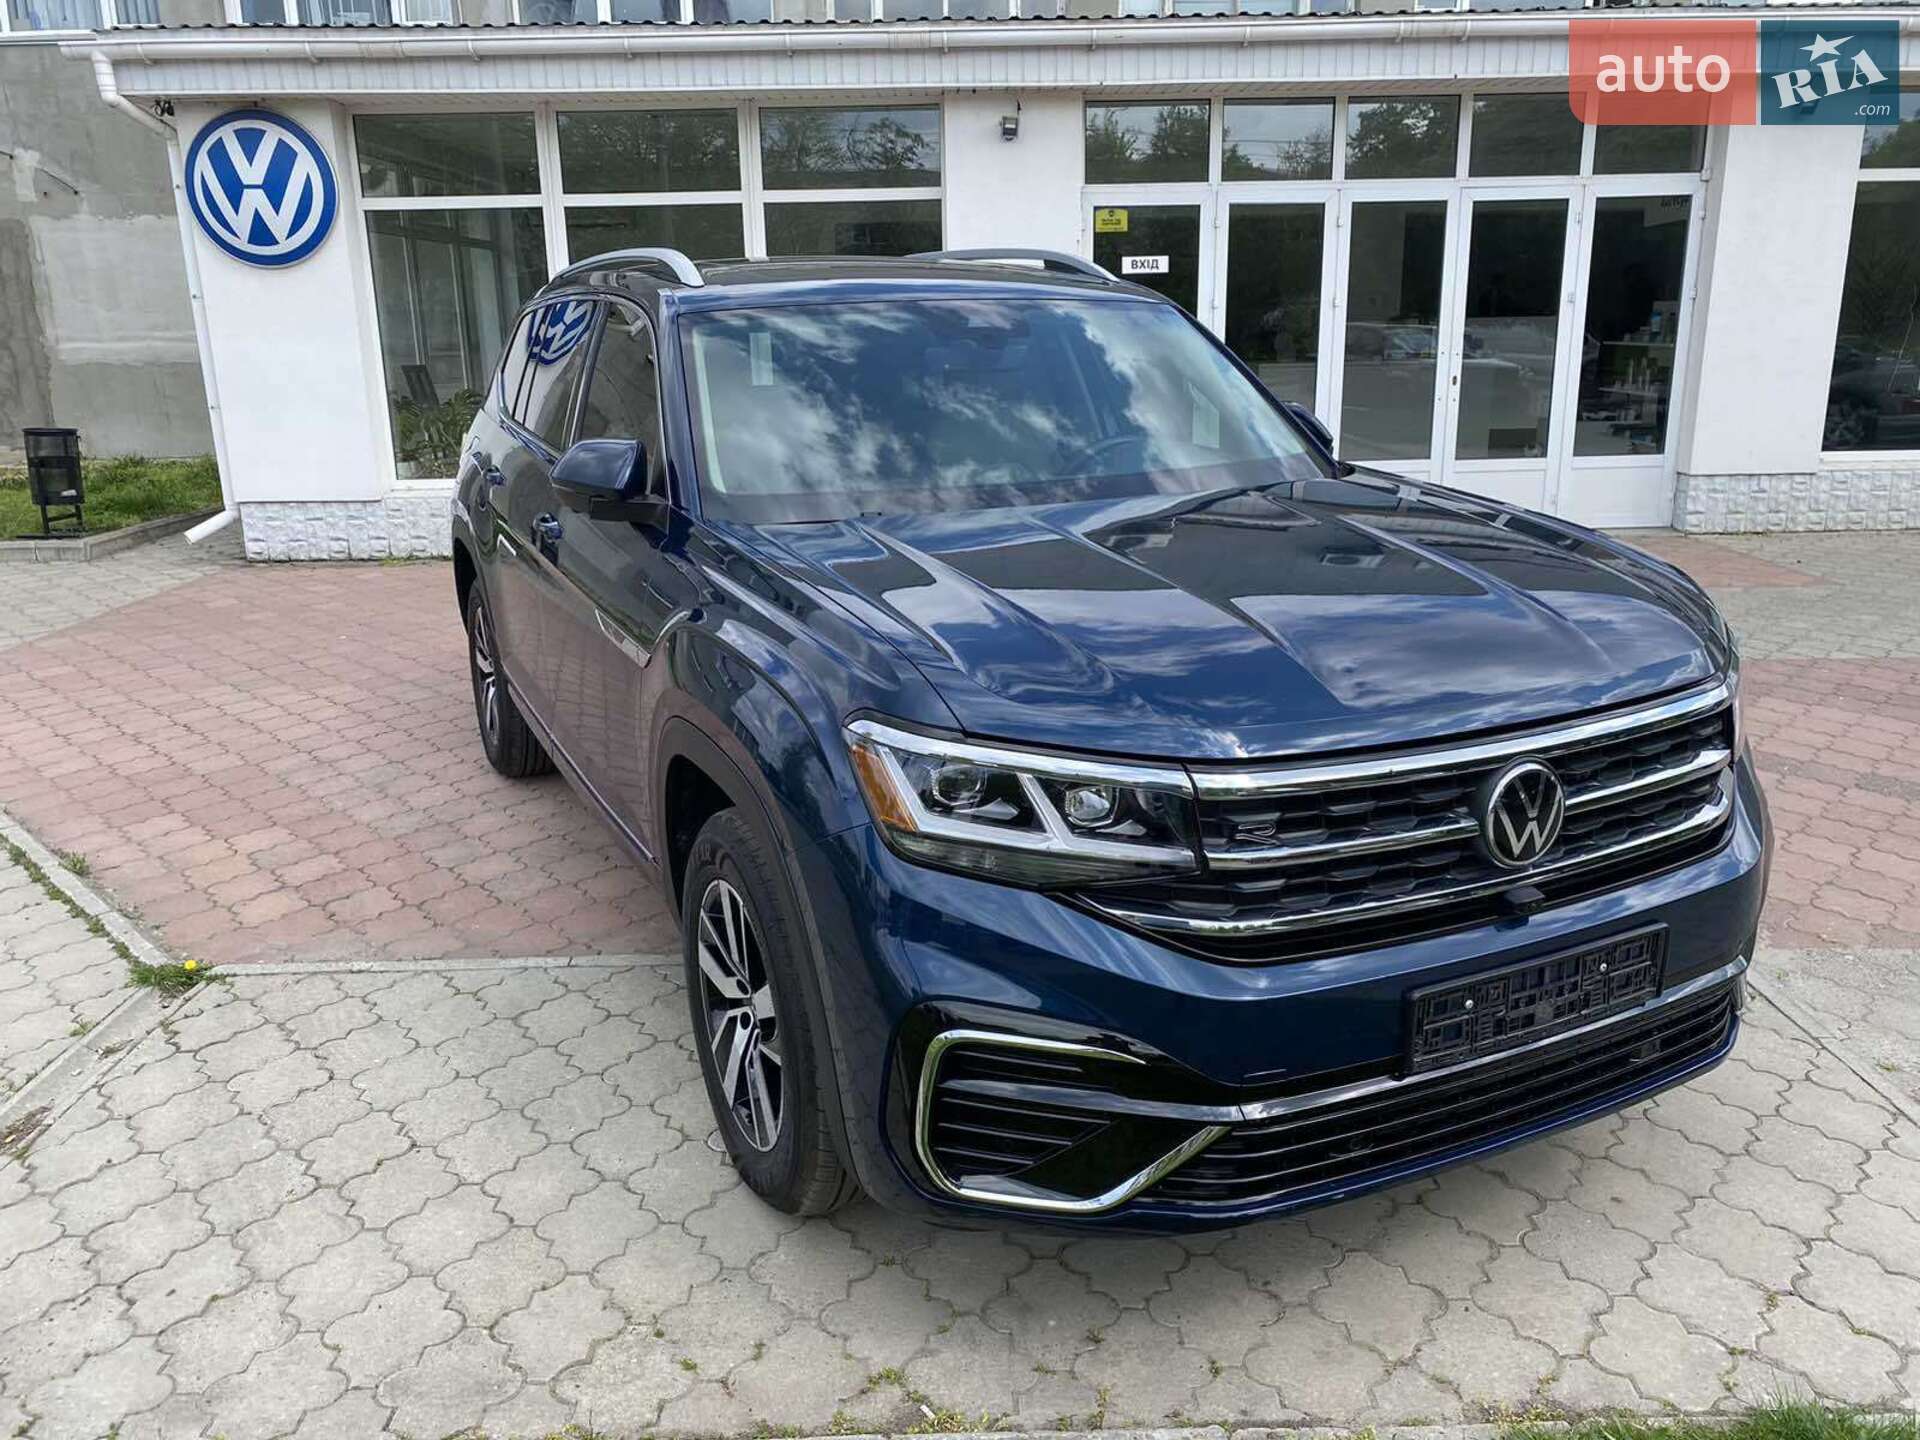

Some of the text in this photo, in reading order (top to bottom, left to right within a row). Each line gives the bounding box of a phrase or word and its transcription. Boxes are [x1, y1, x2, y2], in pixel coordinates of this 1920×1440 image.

[197, 122, 320, 250] VW
[1131, 259, 1159, 270] ВХІД
[1492, 766, 1561, 861] VW
